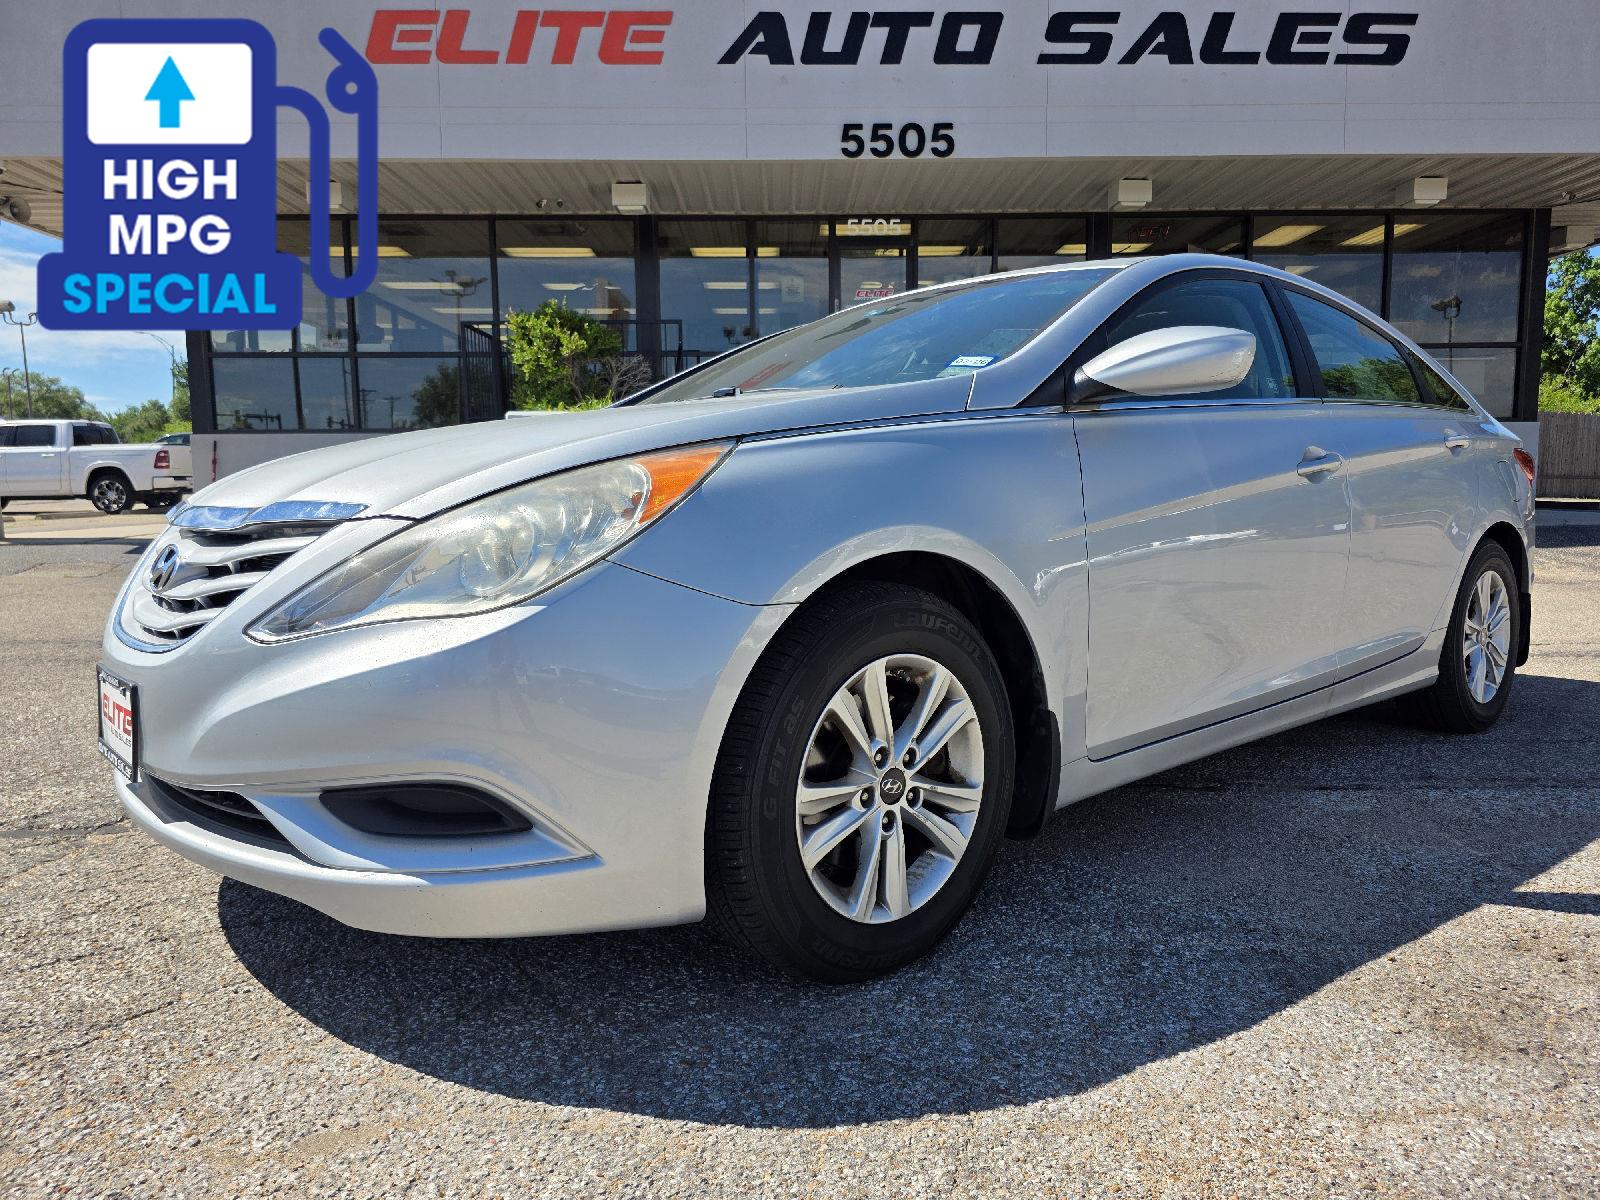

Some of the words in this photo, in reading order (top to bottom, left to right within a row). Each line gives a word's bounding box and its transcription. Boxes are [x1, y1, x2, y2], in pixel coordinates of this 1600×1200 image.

[366, 10, 673, 65] ELITE
[717, 11, 1005, 65] AUTO
[1037, 11, 1419, 65] SALES
[841, 123, 955, 158] 5505
[847, 218, 901, 236] 5505
[856, 289, 895, 298] ELITE
[102, 692, 133, 737] ELITE
